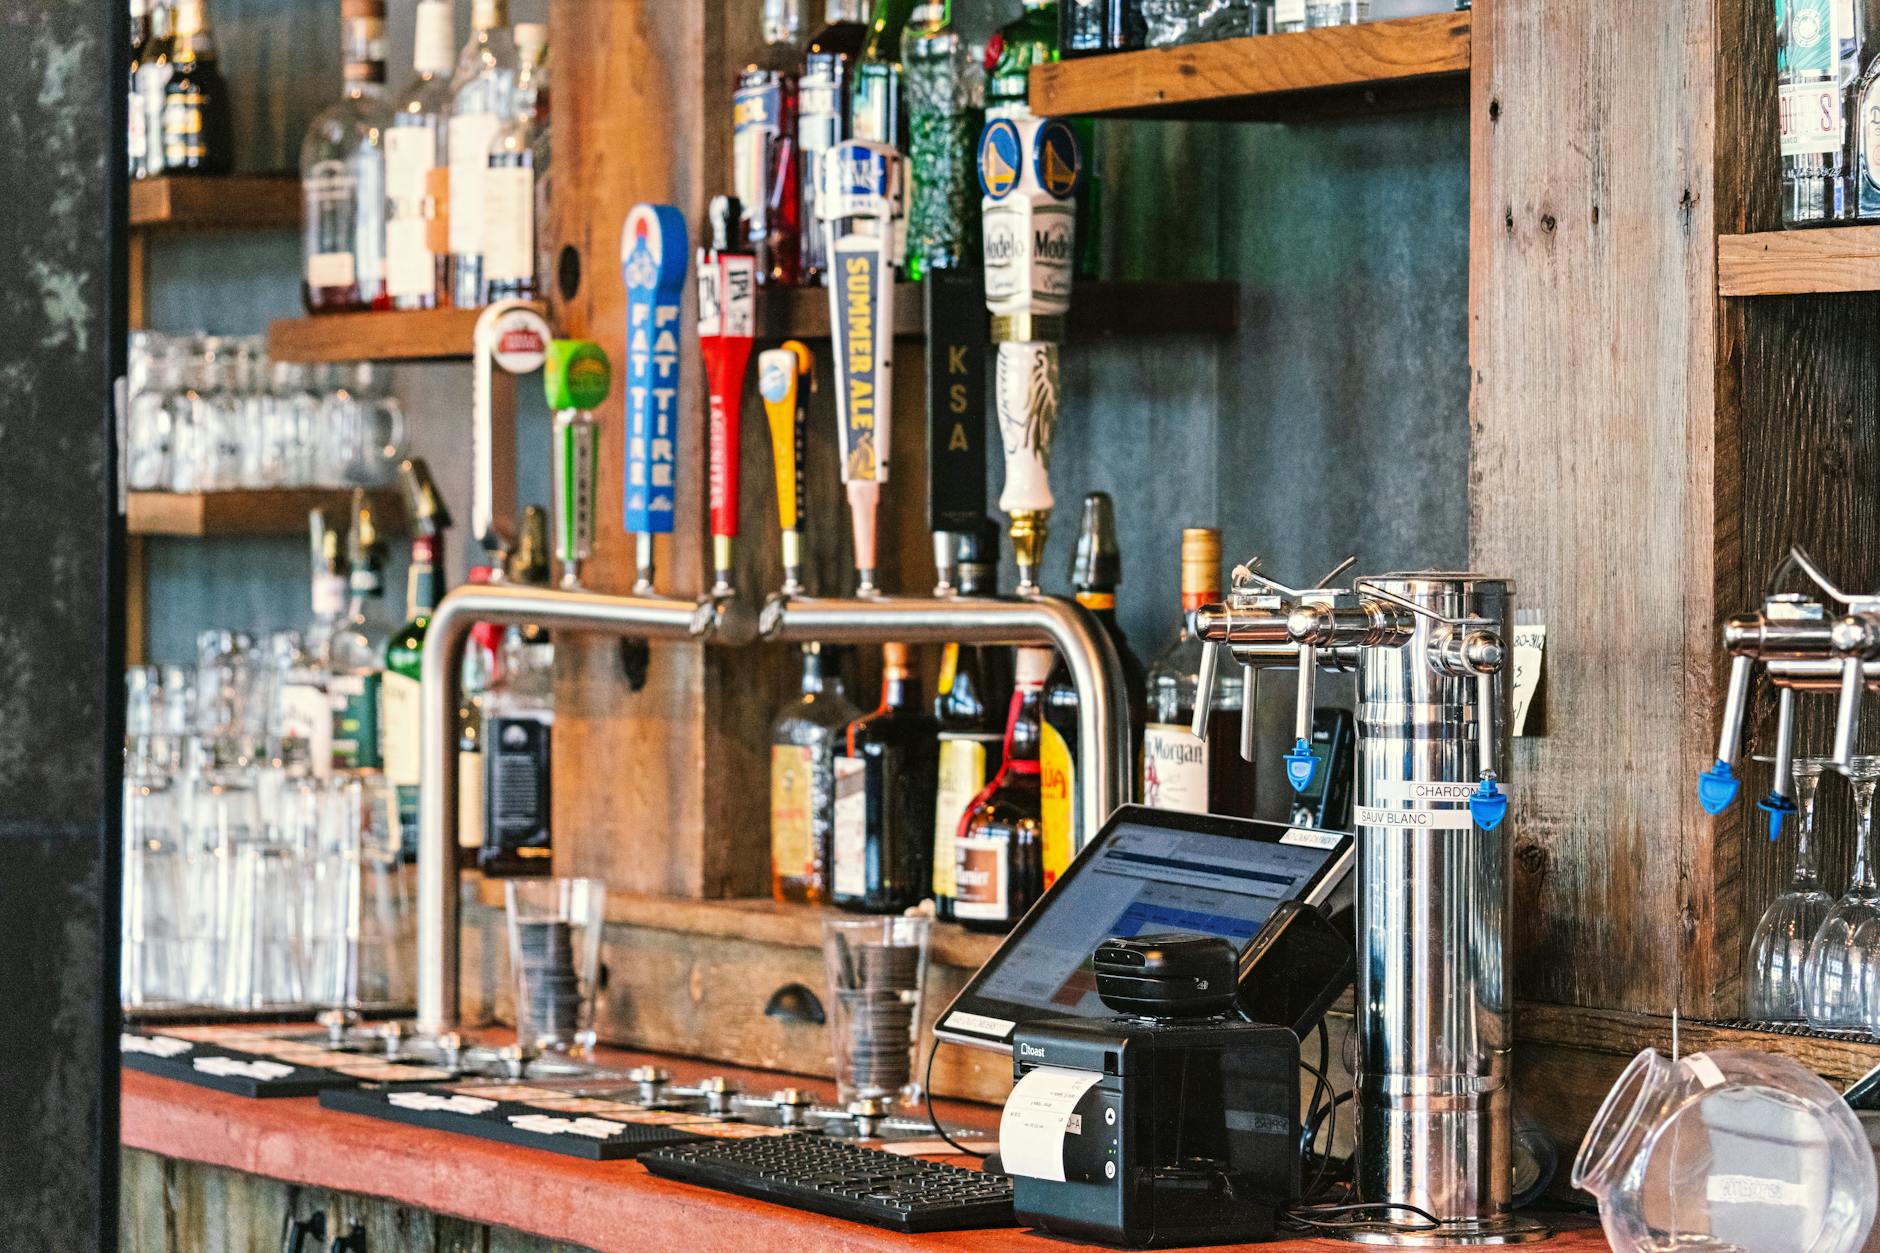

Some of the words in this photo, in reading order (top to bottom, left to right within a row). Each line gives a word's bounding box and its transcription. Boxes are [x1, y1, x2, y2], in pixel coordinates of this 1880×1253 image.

[631, 303, 649, 378] FAT
[653, 305, 679, 378] FAT
[846, 256, 873, 375] SUMMER
[850, 381, 875, 432] ALE
[948, 345, 970, 451] KSA
[651, 388, 674, 486] TIRE
[1154, 736, 1203, 765] Morgan
[1361, 810, 1385, 823] SAUV
[1387, 812, 1427, 825] BLANC
[1027, 1046, 1045, 1058] toast
